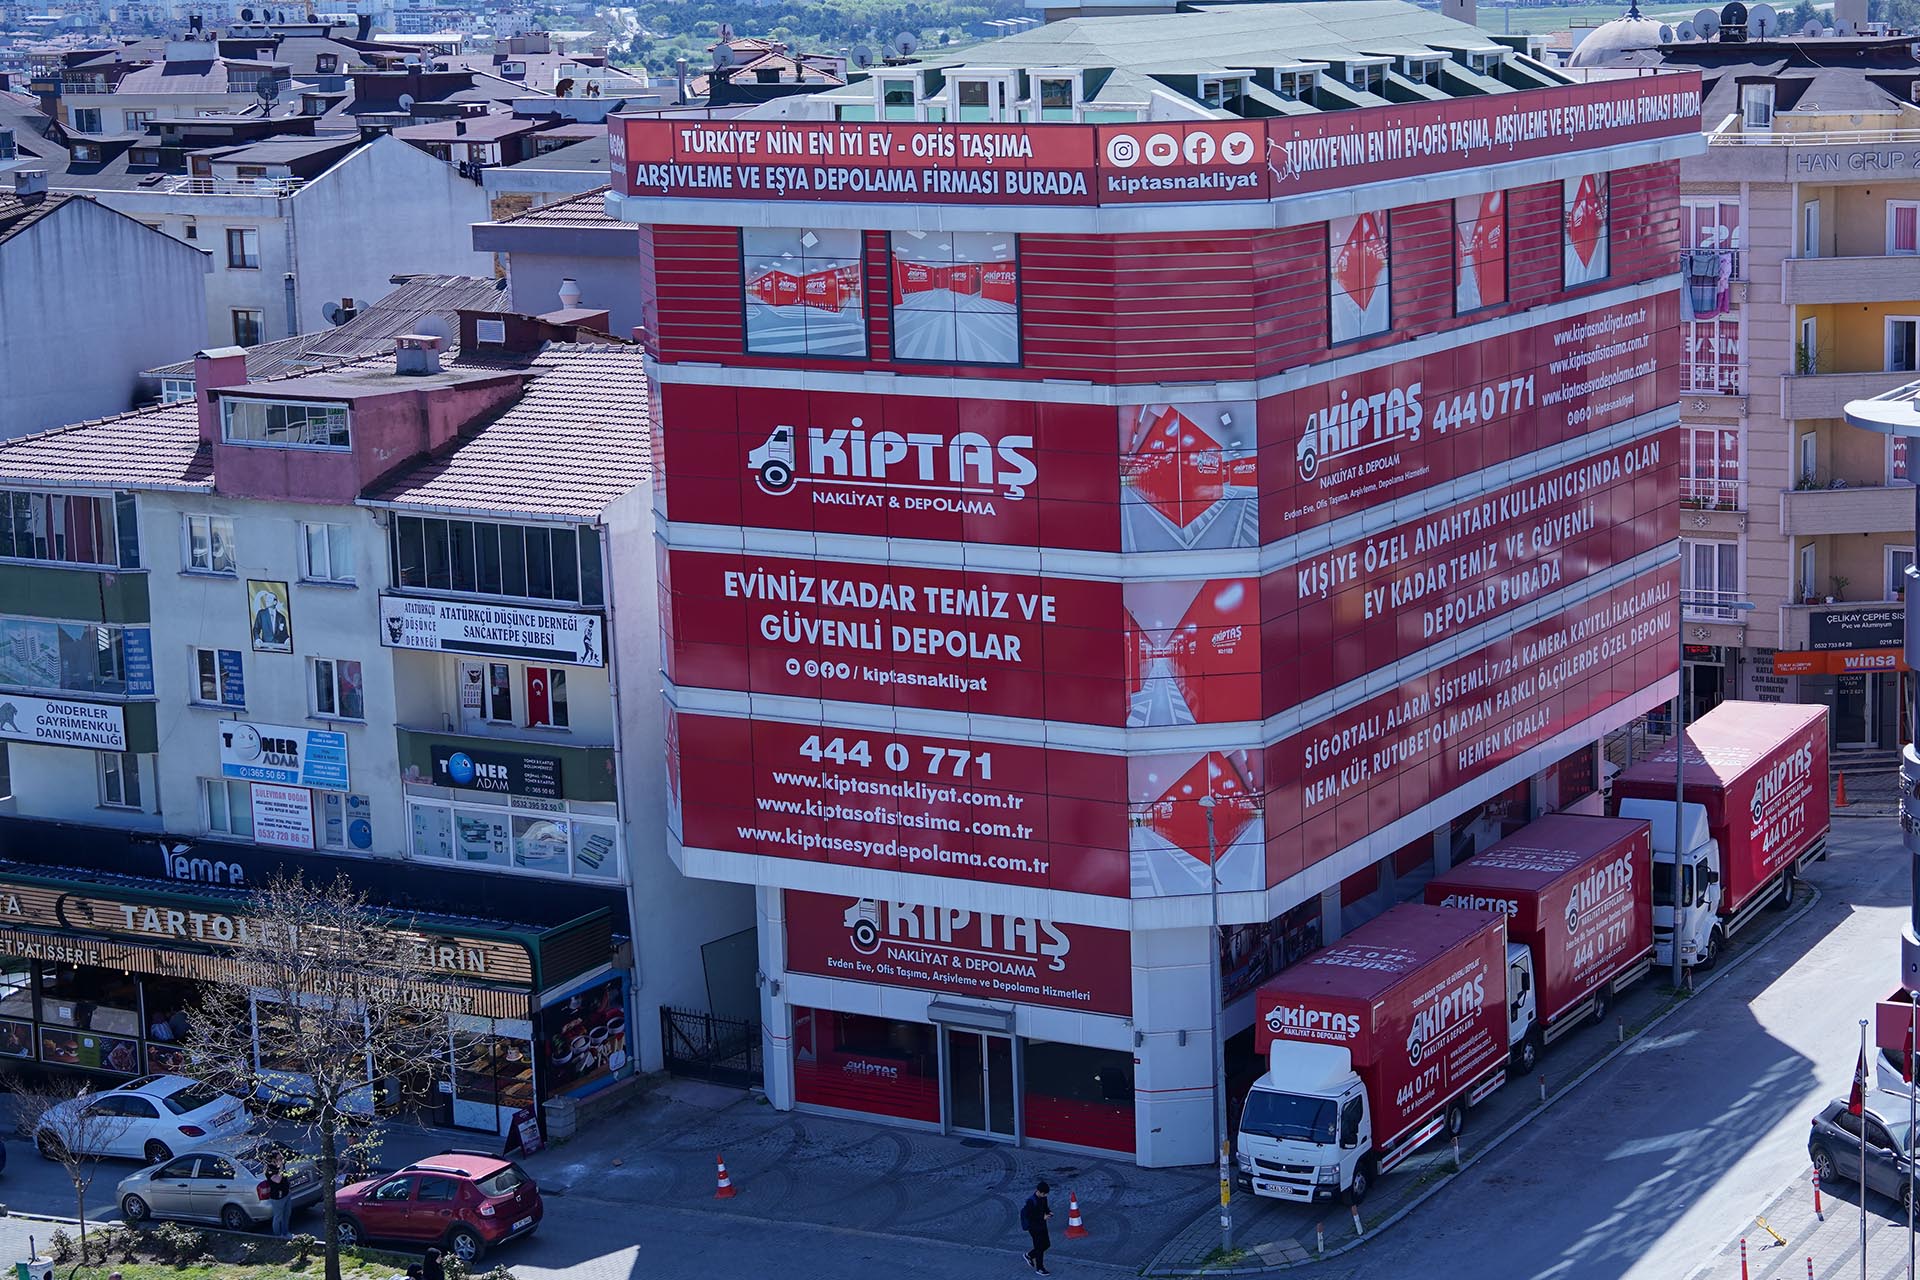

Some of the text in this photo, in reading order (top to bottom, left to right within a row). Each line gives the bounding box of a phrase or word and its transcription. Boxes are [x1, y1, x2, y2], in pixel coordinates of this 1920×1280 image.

[767, 124, 802, 154] NİN
[809, 132, 833, 155] EN
[840, 125, 863, 156] İYİ
[869, 133, 893, 156] EV
[912, 127, 954, 158] OFİS
[960, 134, 1034, 164] TAŞIMA
[1368, 134, 1385, 163] EN
[1387, 119, 1402, 159] İYİ
[1494, 106, 1548, 150] ARŞİVLEME
[1551, 108, 1564, 135] VE
[1564, 106, 1587, 142] EŞYA
[1588, 97, 1635, 131] DEPOLAMA
[1638, 90, 1671, 125] FİRMASI
[1673, 91, 1701, 118] BURDA
[636, 158, 734, 193] ARŞİVLEME
[737, 167, 760, 189] VE
[765, 167, 809, 195] EŞYA
[814, 168, 918, 194] DEPOLAMA
[923, 163, 999, 194] FİRMASI
[1006, 171, 1088, 195] BURADA
[1107, 172, 1258, 192] kiptasnakliyat
[1796, 152, 1905, 173] HAN GRUP
[1320, 382, 1424, 456] KİPTAŞ
[808, 416, 1038, 501] KİPTAŞ
[1320, 466, 1357, 489] NAKLİYAT
[812, 491, 996, 516] NAKLİYAT & DEPOLAMA
[1298, 441, 1660, 599] KİŞİYE ÖZEL ANAHTARI KULLANICISINDA OLAN
[1364, 500, 1595, 620] EV KADAR TEMİZ VE GÜVENLİ
[724, 567, 1056, 623] EVİNİZ KADAR TEMİZ VE
[1423, 559, 1561, 639] DEPOLAR BURADA
[440, 605, 578, 632] ATATÜRKÇÜ DÜŞÜNCE DERNEĞİ
[463, 625, 555, 647] SANCAKTEPE ŞUBESİ
[760, 610, 1022, 662] GÜVENLİ DEPOLAR
[863, 666, 988, 694] kiptasnakliyat
[1844, 653, 1896, 667] winsa
[1373, 729, 1431, 774] RUTUBET
[1433, 700, 1492, 741] OLMAYAN
[1496, 679, 1536, 712] FARKLI
[1538, 644, 1599, 692] ÖLÇÜLERDE
[1601, 630, 1628, 659] ÖZEL
[1630, 610, 1672, 646] DEPONU
[1386, 693, 1431, 731] ALARM
[1522, 630, 1568, 666] KAMERA
[36, 715, 120, 734] GAYRİMENKUL
[46, 701, 108, 720] ÖNDERLER
[36, 727, 122, 747] DANIŞMANLIĞI
[1458, 737, 1501, 771] HEMEN
[262, 753, 299, 768] ADAM
[800, 735, 992, 780] 444 0 771
[1764, 741, 1812, 801] KİPTAŞ
[475, 778, 510, 791] ADAM
[773, 770, 1024, 810] www.kiptasnakliyat.com.tr
[737, 824, 1049, 874] www.kiptasesyadepolama.com.tr
[1581, 851, 1634, 911] KİPTAŞ
[887, 947, 1036, 978] NAKLİYAT & DEPOLAMA
[1573, 918, 1626, 969] 444 0 771
[827, 957, 853, 969] Evden
[876, 963, 894, 976] Ofis
[932, 970, 977, 986] Arşivleme
[979, 978, 991, 988] ve
[993, 978, 1040, 995] Depolama
[1042, 985, 1091, 1001] Hizmetleri
[1284, 1004, 1360, 1038] KİPTAŞ
[1422, 973, 1485, 1042] KİPTAŞ
[1396, 1062, 1440, 1107] 444 0 771
